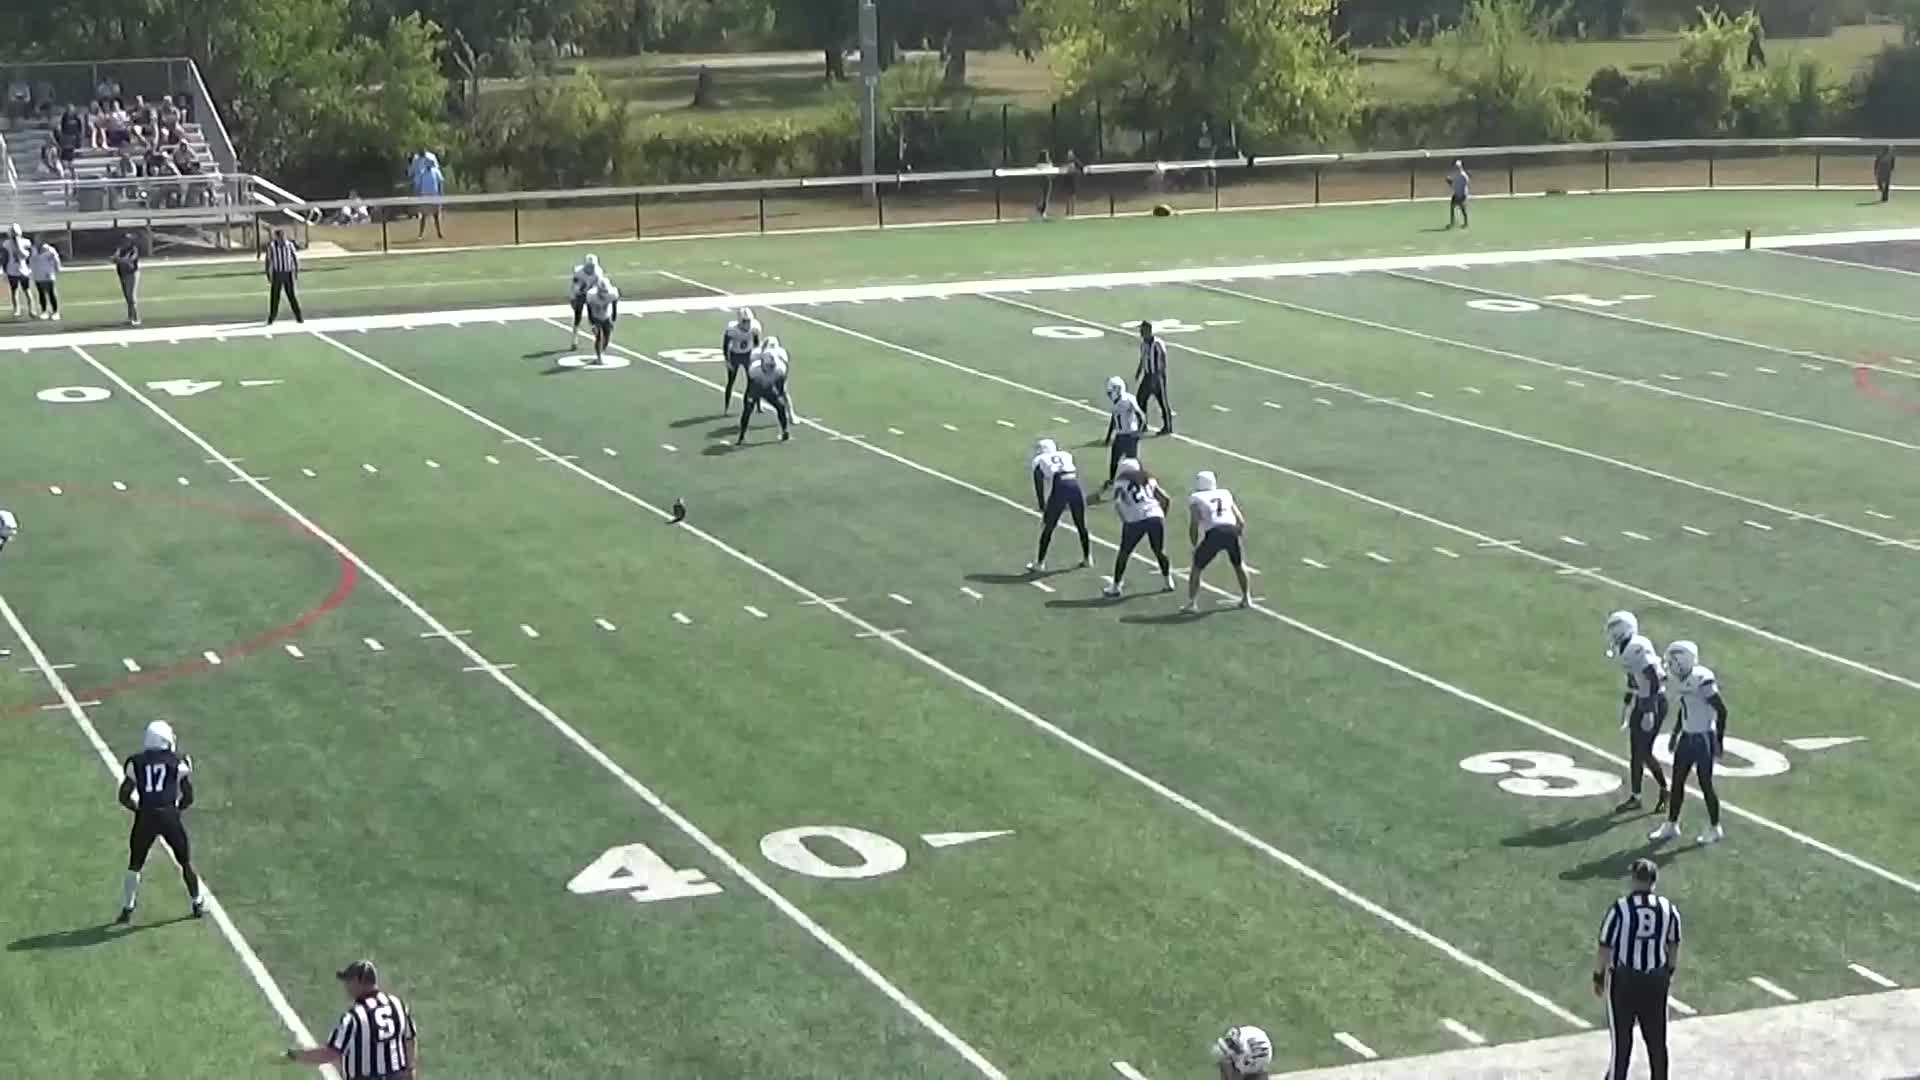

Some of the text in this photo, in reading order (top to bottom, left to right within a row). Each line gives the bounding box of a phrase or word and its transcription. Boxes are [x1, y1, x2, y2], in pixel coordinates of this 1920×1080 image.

[1466, 293, 1625, 312] 10
[36, 379, 223, 403] 40
[145, 763, 167, 793] 17
[1460, 732, 1790, 797] 30
[566, 825, 908, 903] 40
[1636, 907, 1657, 938] B
[374, 1005, 396, 1041] S
